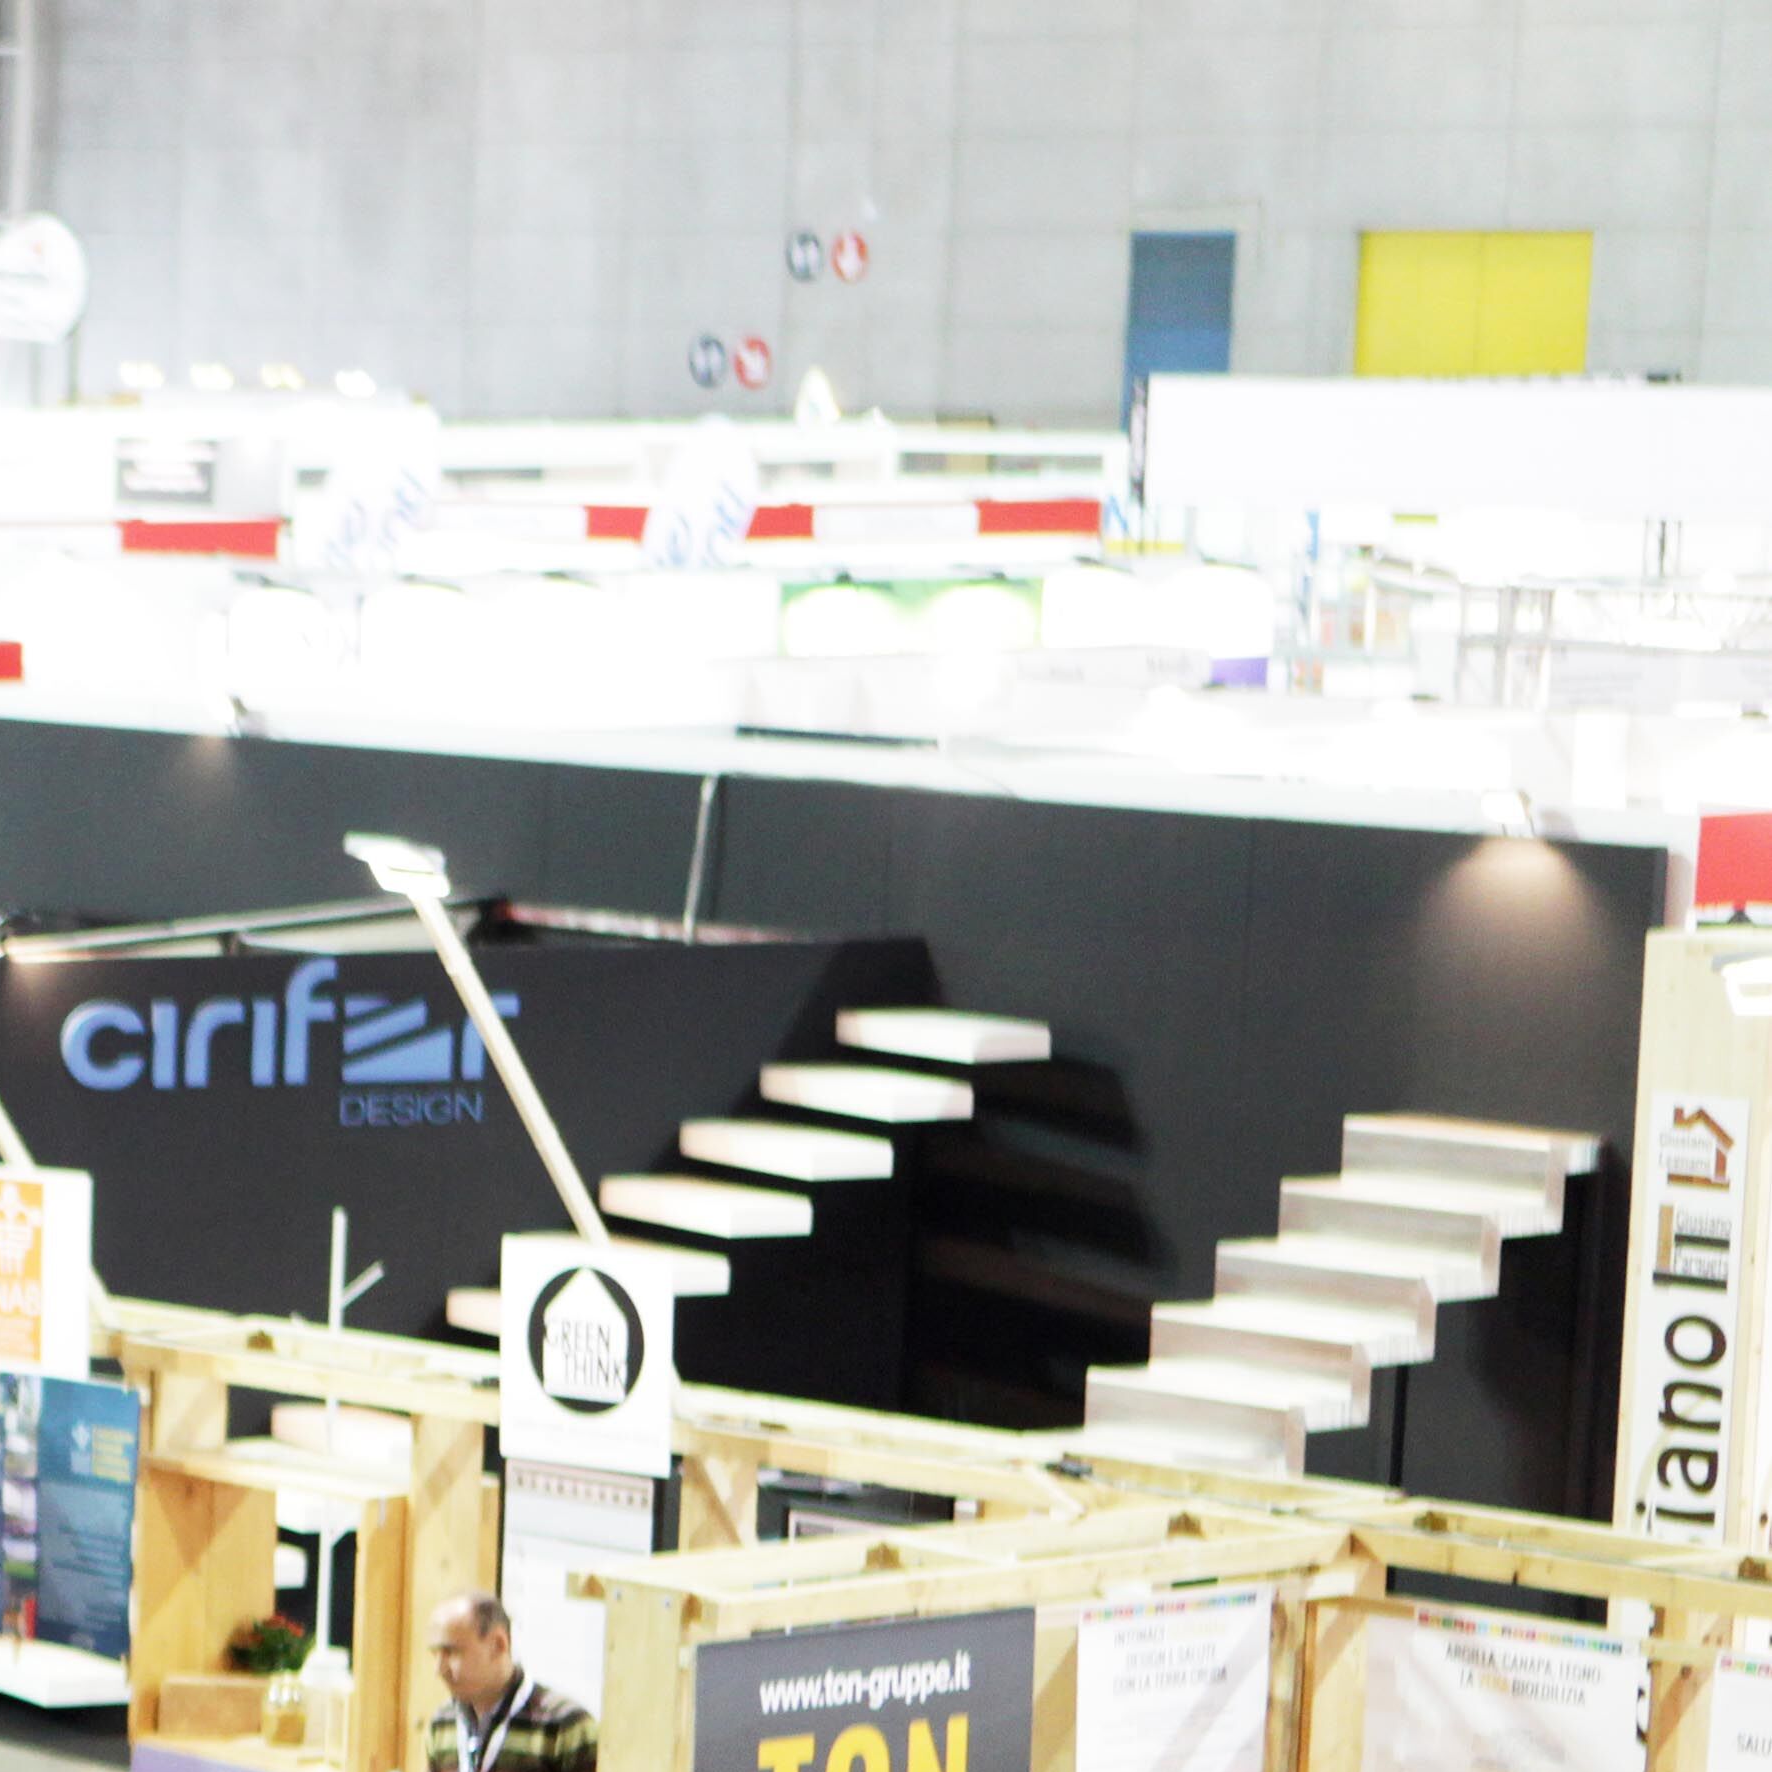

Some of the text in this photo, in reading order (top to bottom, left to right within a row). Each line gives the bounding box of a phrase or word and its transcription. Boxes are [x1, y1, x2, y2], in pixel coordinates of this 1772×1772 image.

[338, 1091, 485, 1127] DESIGN
[543, 1317, 611, 1352] GREEN
[562, 1351, 628, 1387] THINK
[759, 1650, 971, 1716] www.ton-gruppe.it
